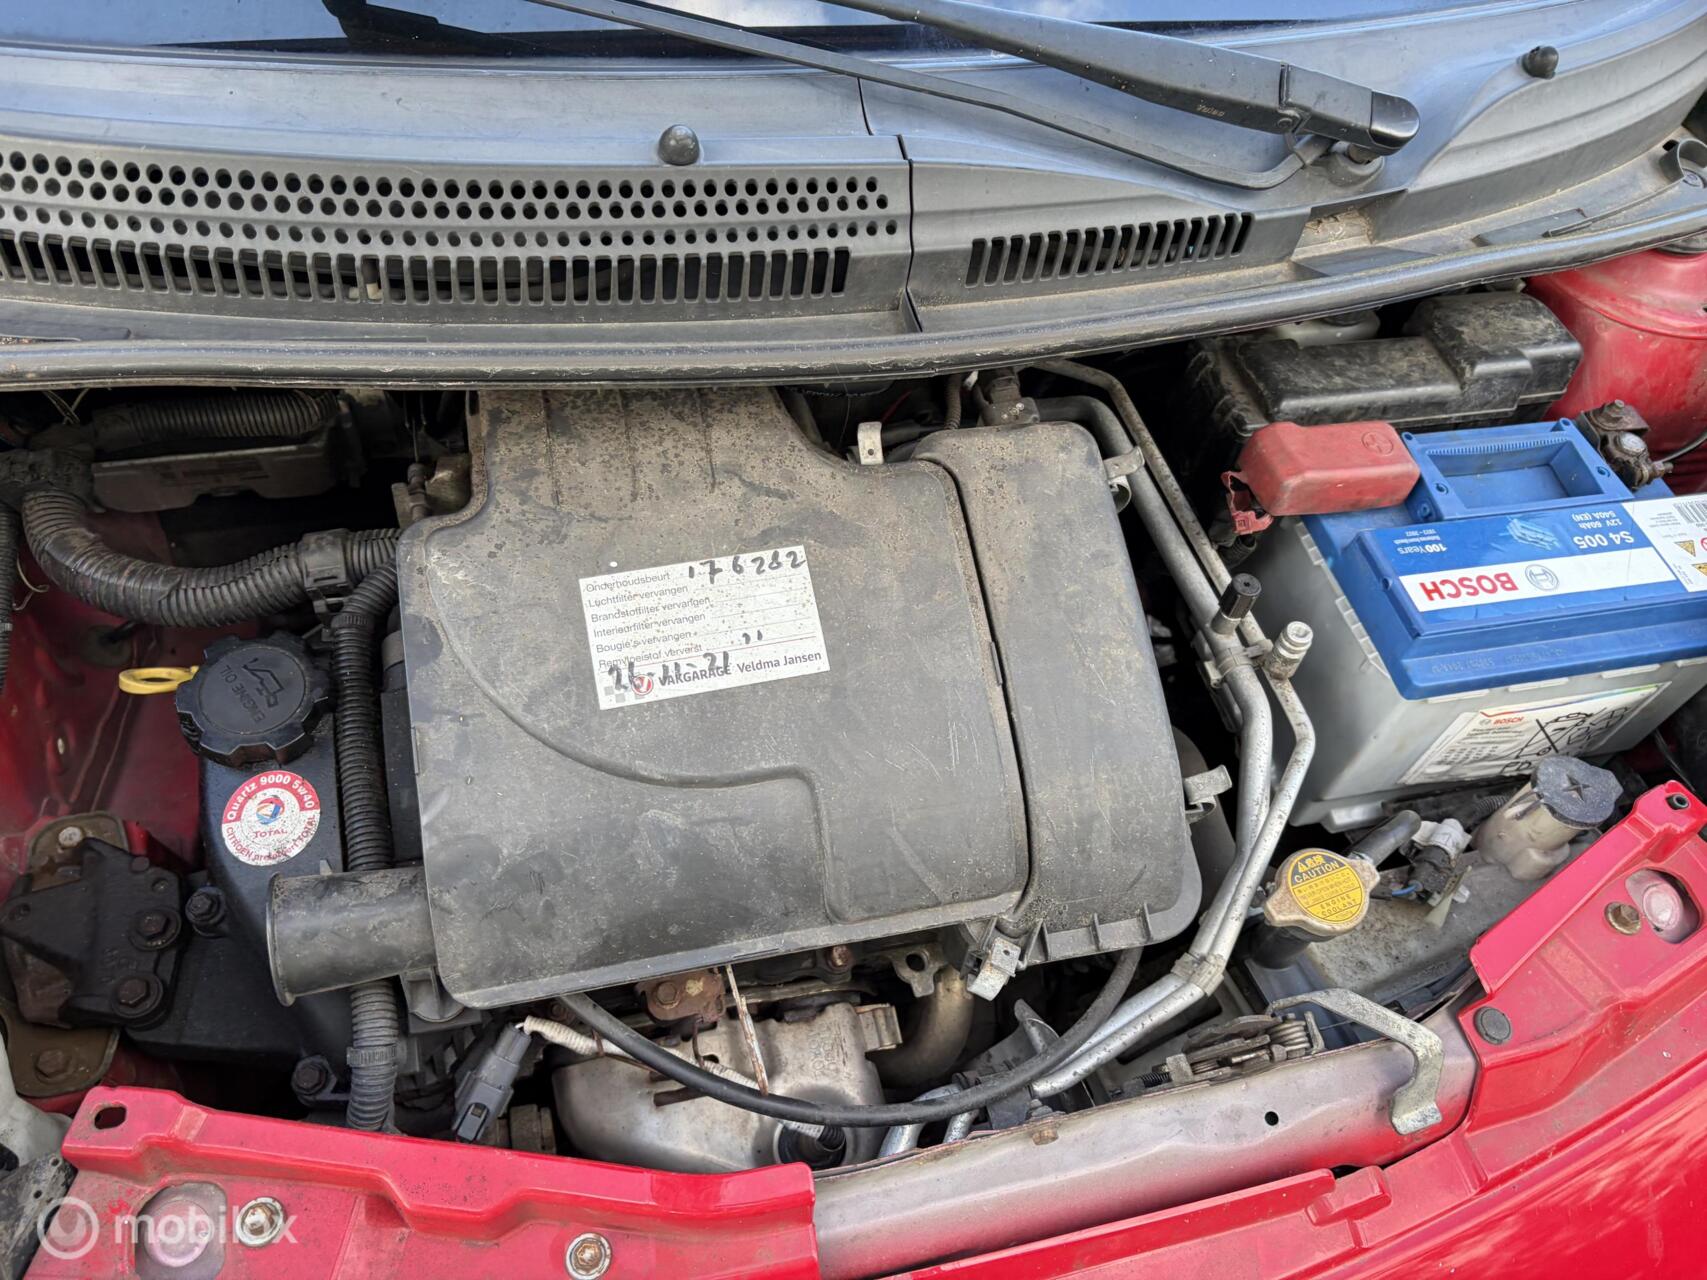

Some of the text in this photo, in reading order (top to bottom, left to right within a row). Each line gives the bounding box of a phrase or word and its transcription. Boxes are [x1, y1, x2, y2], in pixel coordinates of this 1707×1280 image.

[1573, 530, 1634, 549] S4 005
[586, 572, 671, 593] Onderhoudsbeurt
[1419, 572, 1519, 601] BOSCH
[588, 585, 688, 608] Luchtfilter vervangen
[591, 596, 710, 623] Brandstoffilter vervangen
[654, 613, 706, 628] vervangen
[640, 631, 692, 646] vervangen
[658, 651, 822, 687] VAKGARAGE Veldma Jansen
[219, 664, 266, 723] ENGINE OIL
[226, 783, 258, 821] Quartz
[259, 774, 291, 786] 9000
[254, 828, 288, 839] TOTAL
[300, 814, 316, 844] TOTAL
[1294, 860, 1340, 884] CAUTION
[1320, 893, 1351, 910] ENGINE
[1321, 898, 1358, 917] COOLANT
